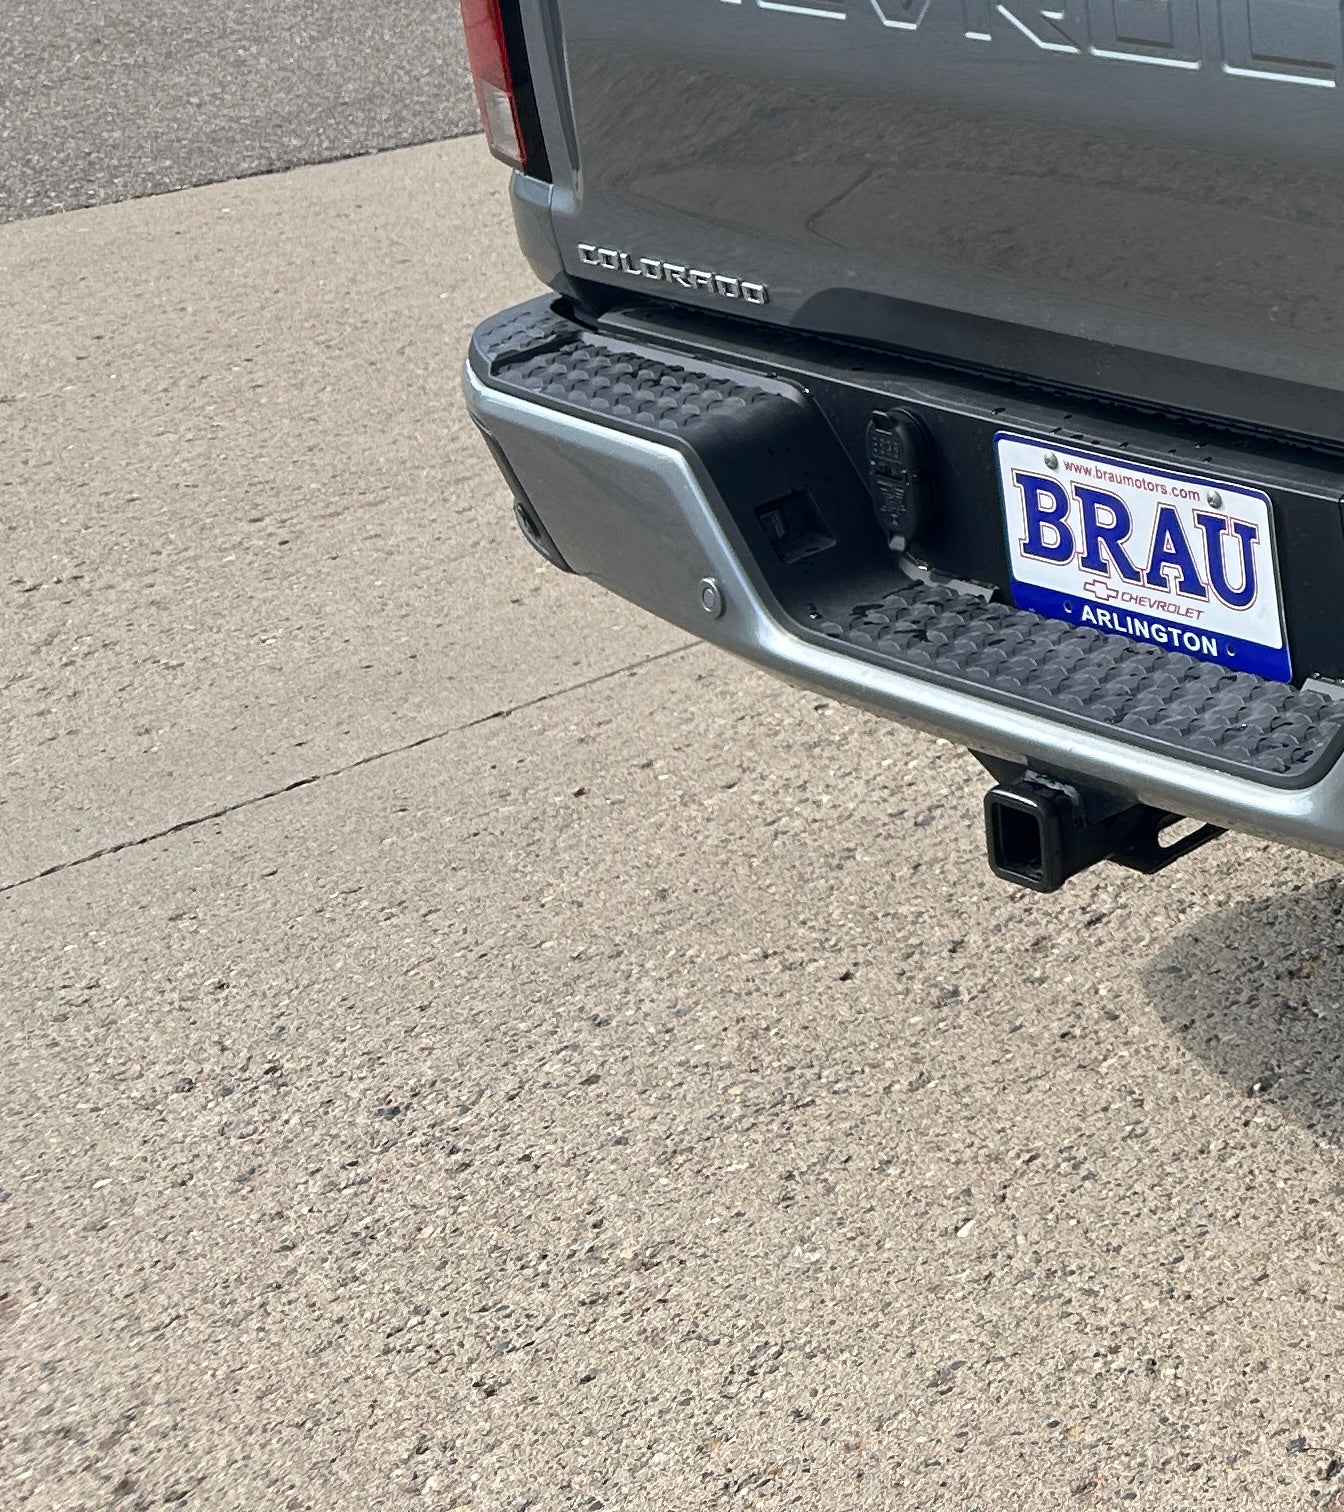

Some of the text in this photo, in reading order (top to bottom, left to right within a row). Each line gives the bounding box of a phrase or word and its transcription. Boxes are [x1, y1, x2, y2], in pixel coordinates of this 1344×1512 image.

[577, 242, 769, 305] COLORADO
[1063, 460, 1201, 502] www.braumotors.com
[1012, 468, 1260, 611] BRAU
[1082, 605, 1218, 656] ARLINGTON
[1121, 592, 1204, 620] CHEVROLET
